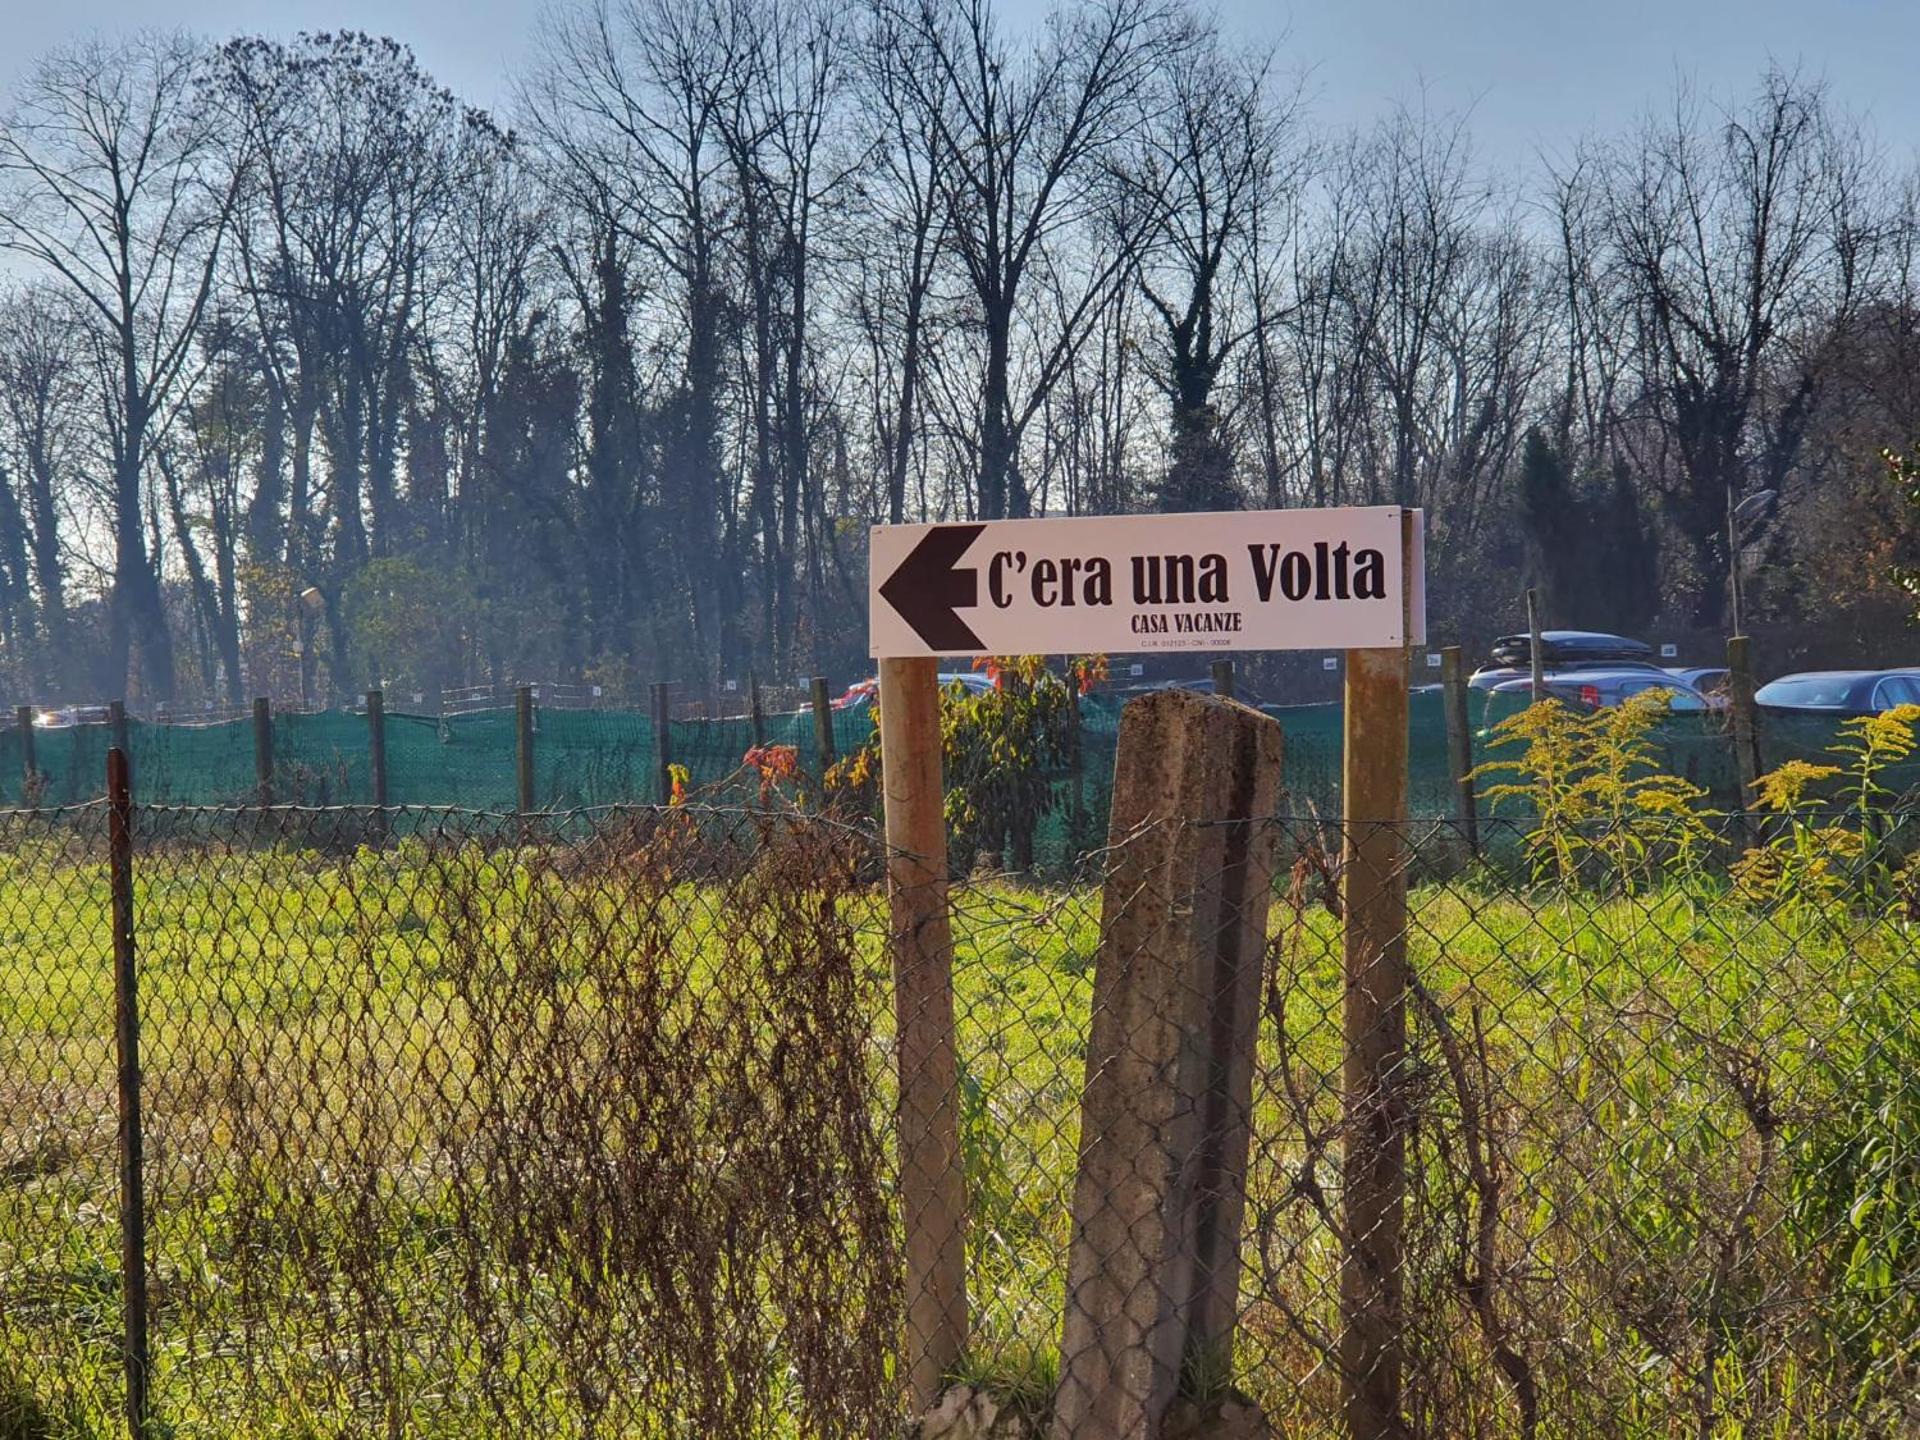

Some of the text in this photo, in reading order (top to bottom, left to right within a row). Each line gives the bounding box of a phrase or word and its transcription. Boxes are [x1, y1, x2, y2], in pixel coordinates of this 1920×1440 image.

[988, 540, 1387, 609] C'era una Volta
[1131, 612, 1242, 634] CASA VACANZE
